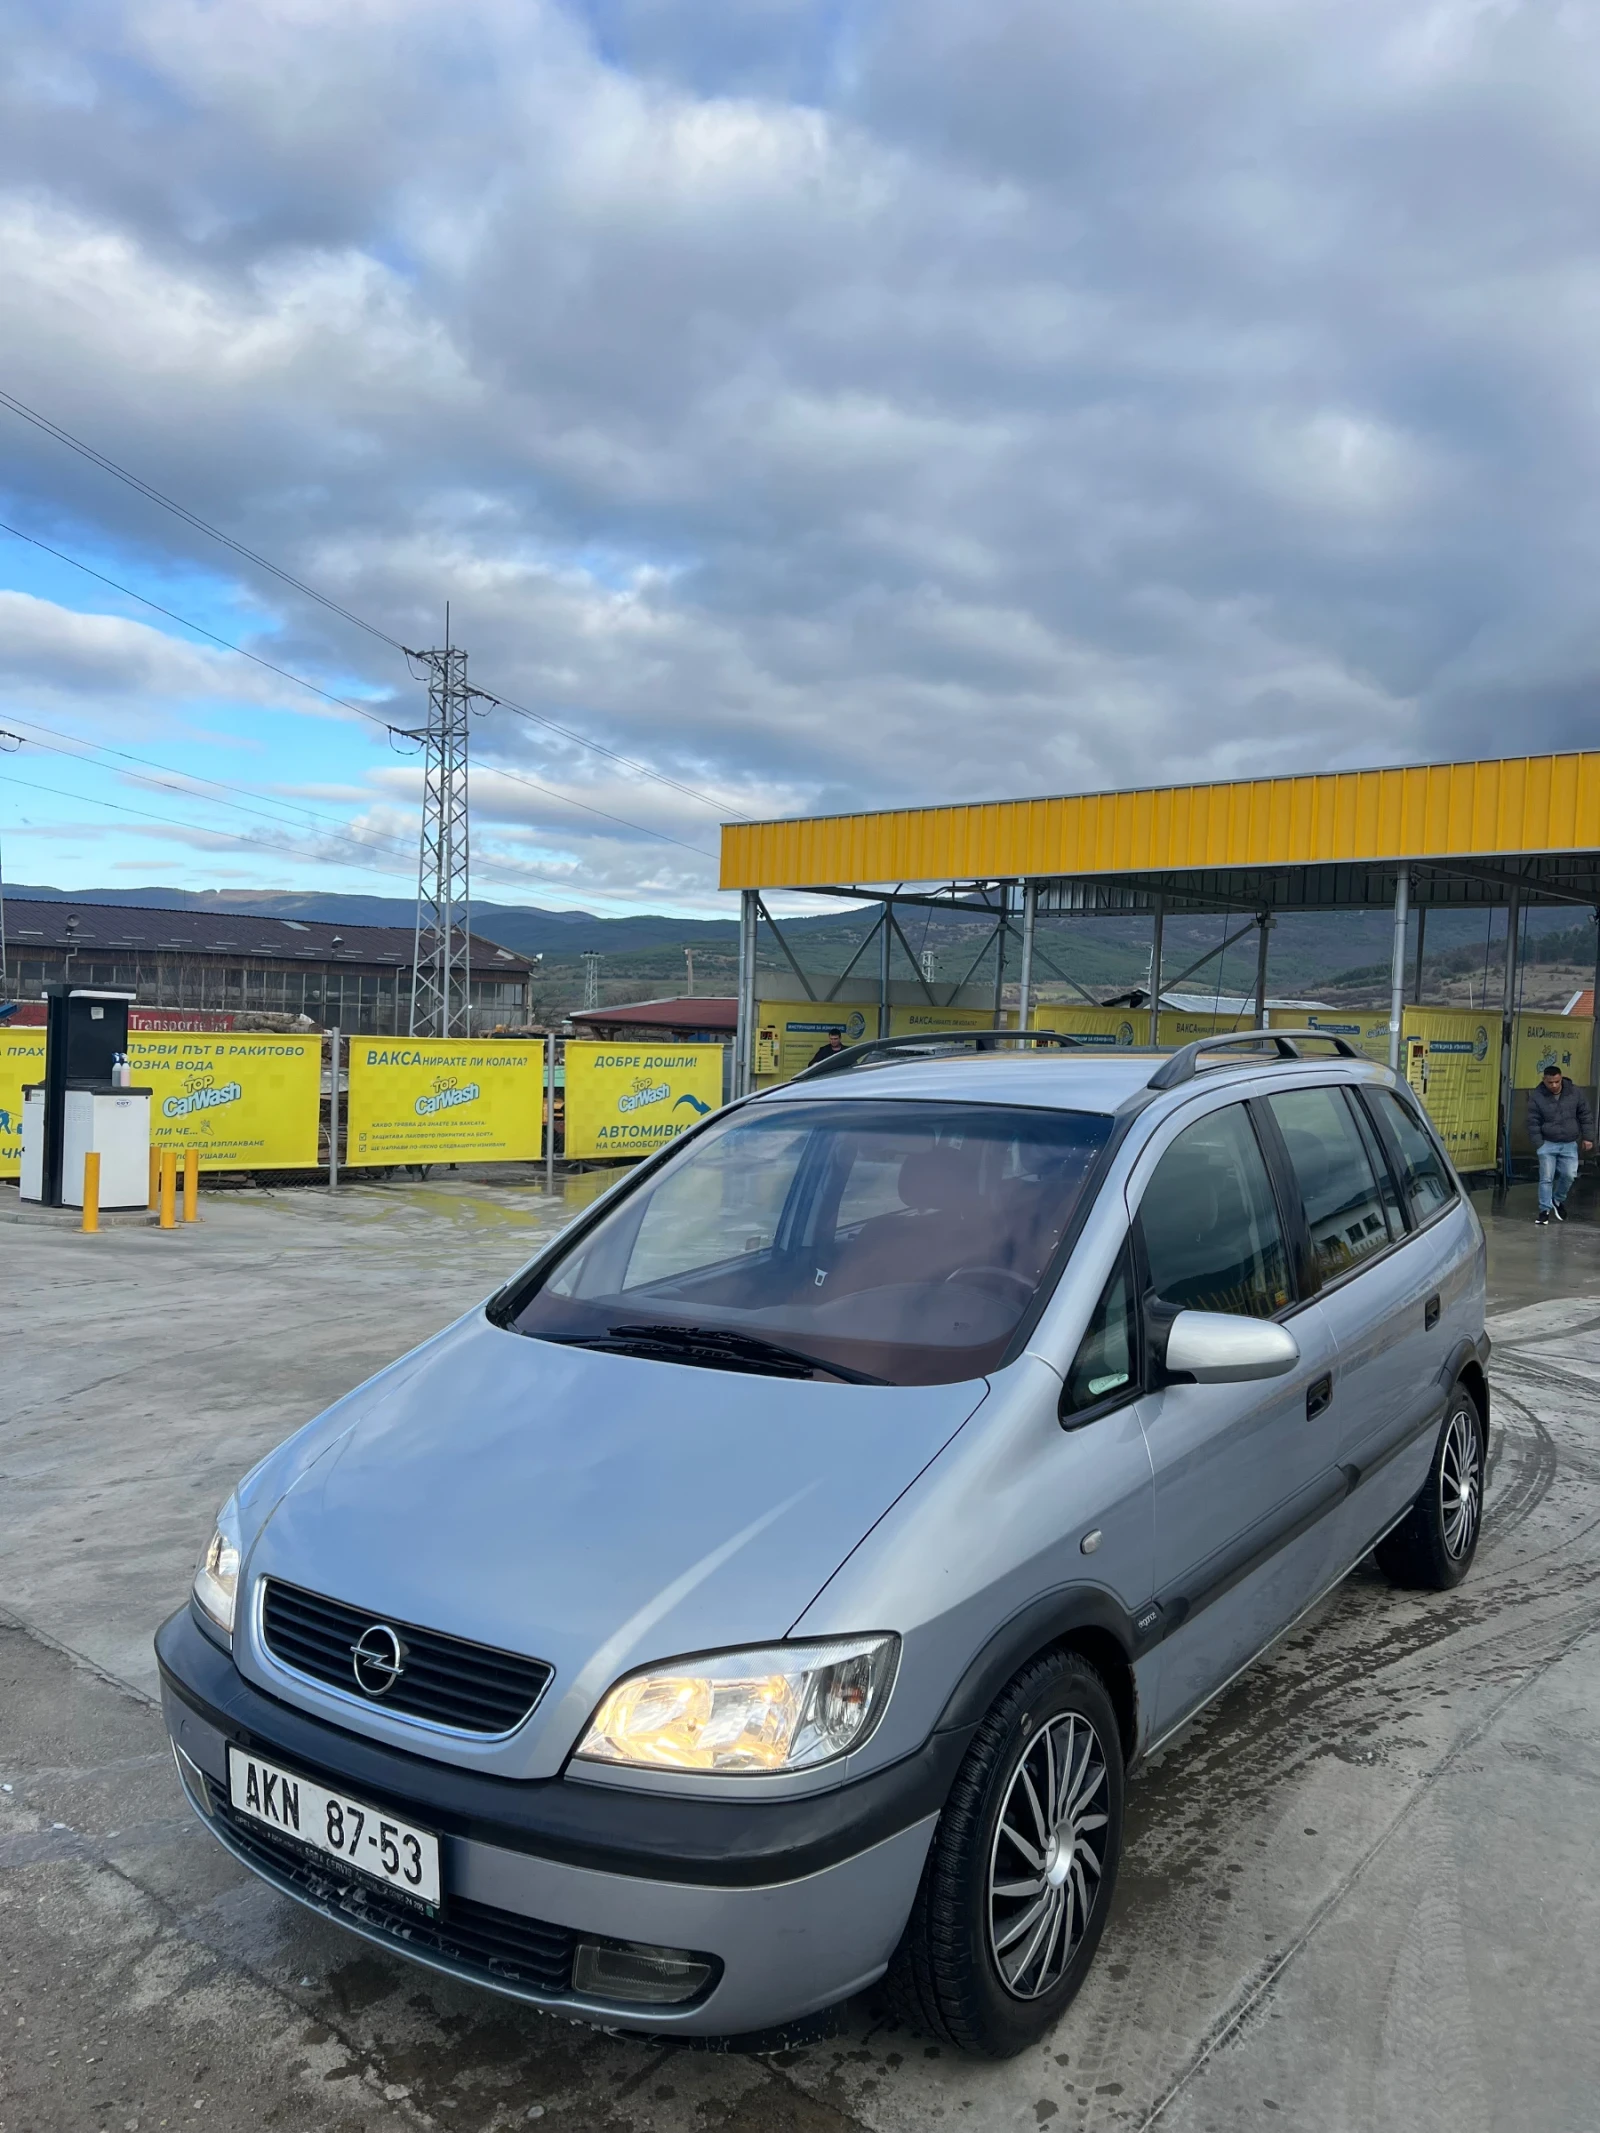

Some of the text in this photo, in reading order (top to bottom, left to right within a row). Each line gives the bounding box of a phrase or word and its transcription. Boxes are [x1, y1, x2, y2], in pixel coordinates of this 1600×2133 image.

[7, 1047, 45, 1056] ПРАХ
[127, 1044, 305, 1056] ПЪРВИ ПЪТ В РАКИТОВО
[367, 1050, 528, 1066] ВАКСАНИРАХТЕ ЛИ КОЛАТА?
[175, 1060, 214, 1071] ВОДА
[594, 1056, 698, 1068] ДОБРЕ ДОШЛИ!
[184, 1075, 214, 1093] TOP
[433, 1077, 457, 1093] TOP
[632, 1078, 652, 1092] TOP
[163, 1081, 241, 1117] CarWash
[415, 1083, 480, 1115] CarWash
[618, 1083, 670, 1113] CarWash
[155, 1128, 172, 1136] ЛИ
[246, 1762, 422, 1885] AKN 87-53
